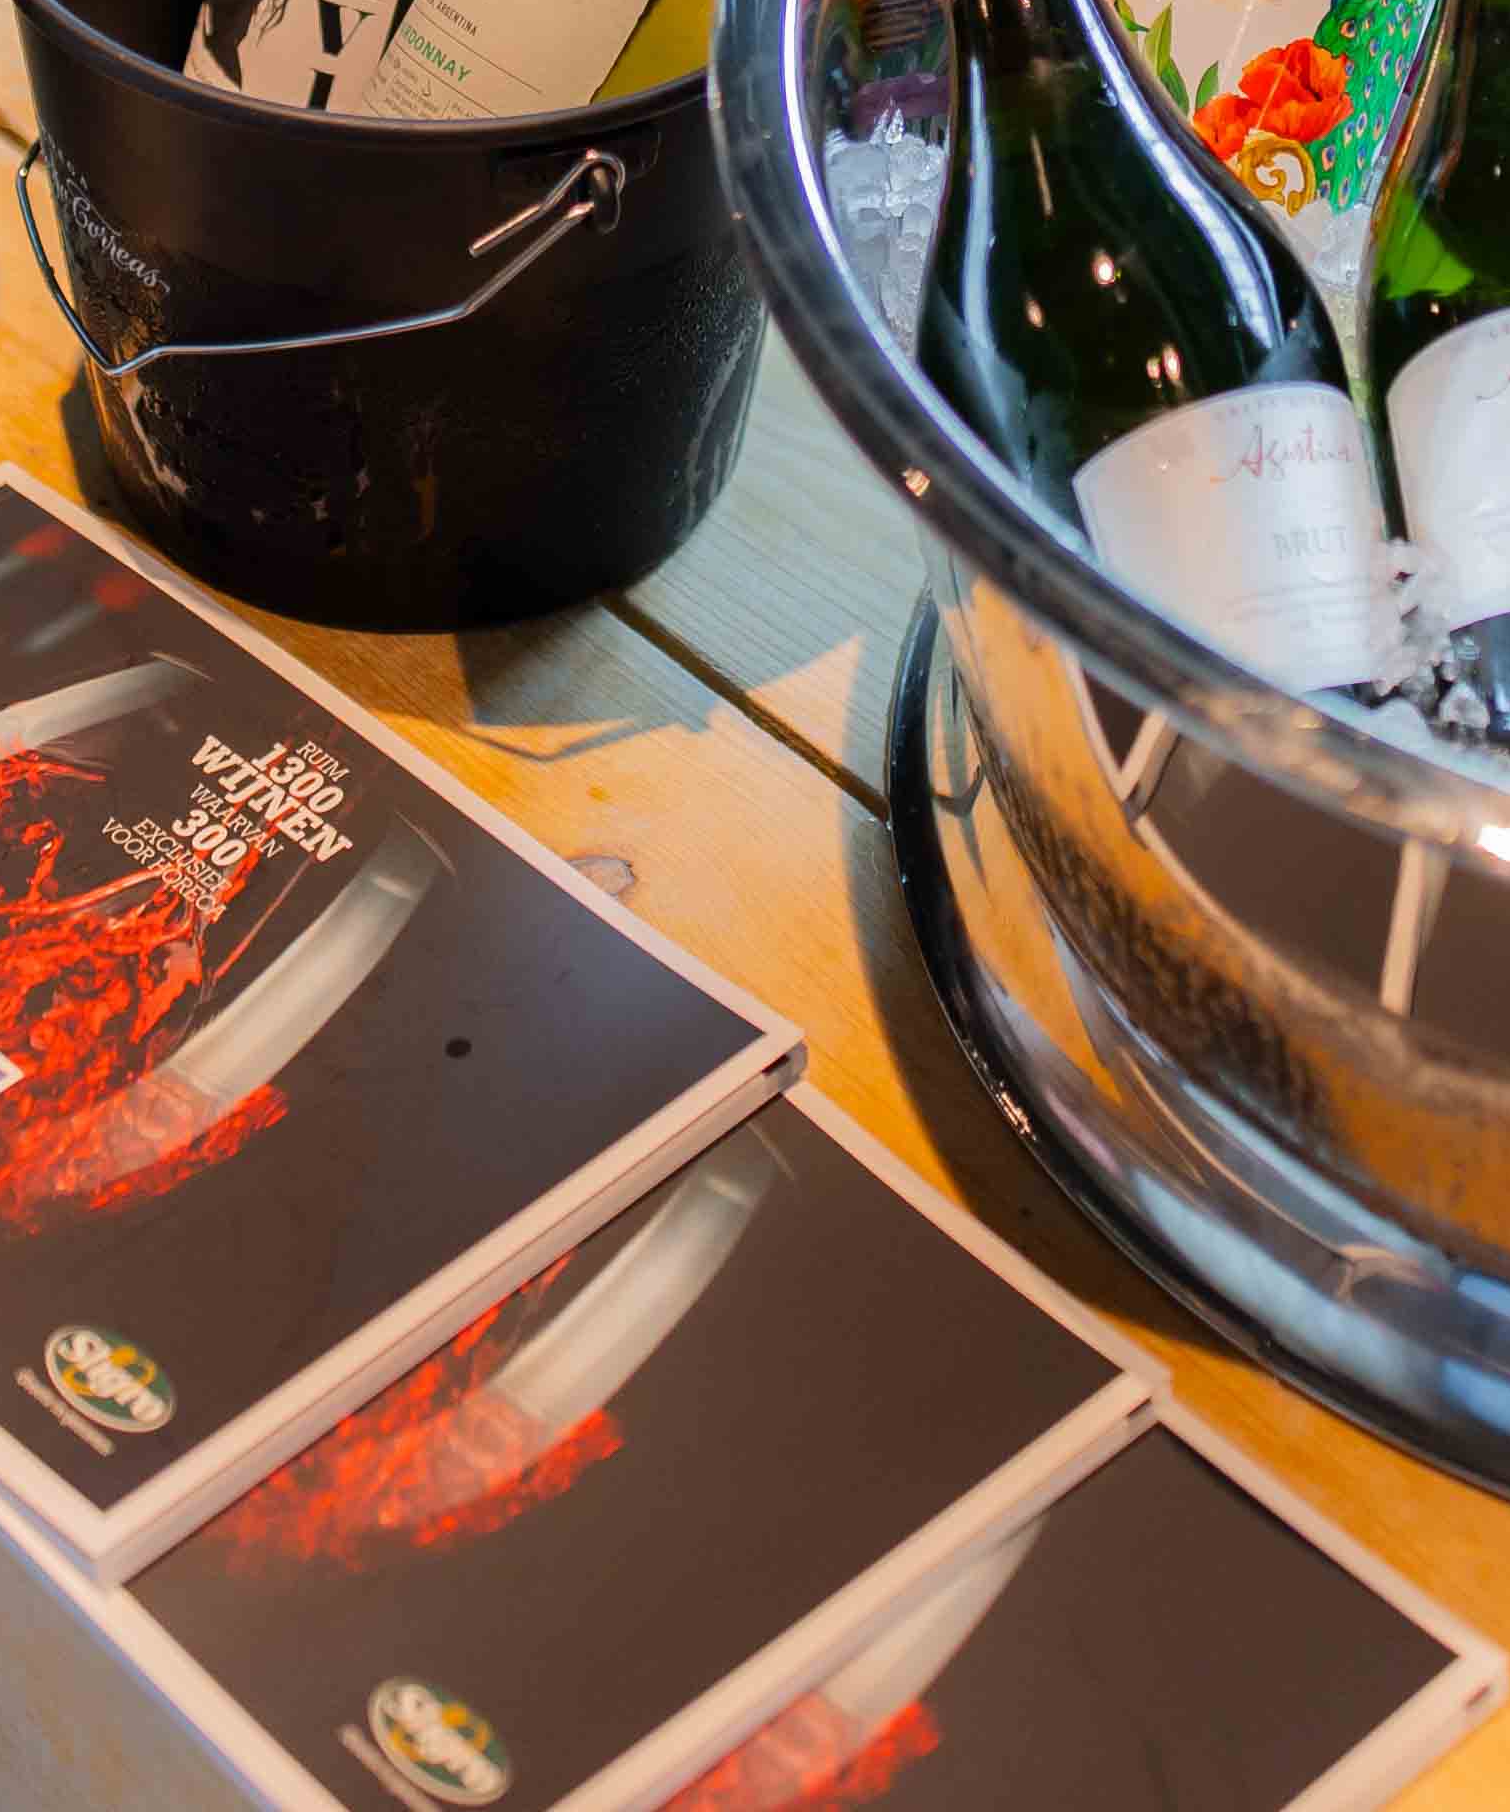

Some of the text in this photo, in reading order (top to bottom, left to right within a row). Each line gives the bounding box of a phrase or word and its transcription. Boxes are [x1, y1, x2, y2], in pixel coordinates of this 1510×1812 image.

[1273, 524, 1347, 561] BRUT
[191, 733, 354, 863] WIJNEN
[251, 742, 345, 814] 1300
[296, 740, 351, 783] RUIM
[132, 817, 233, 892] EXCLUSIEF
[171, 809, 248, 868] 300
[190, 782, 285, 859] WAARVAN
[101, 816, 227, 926] VOOR HORECA
